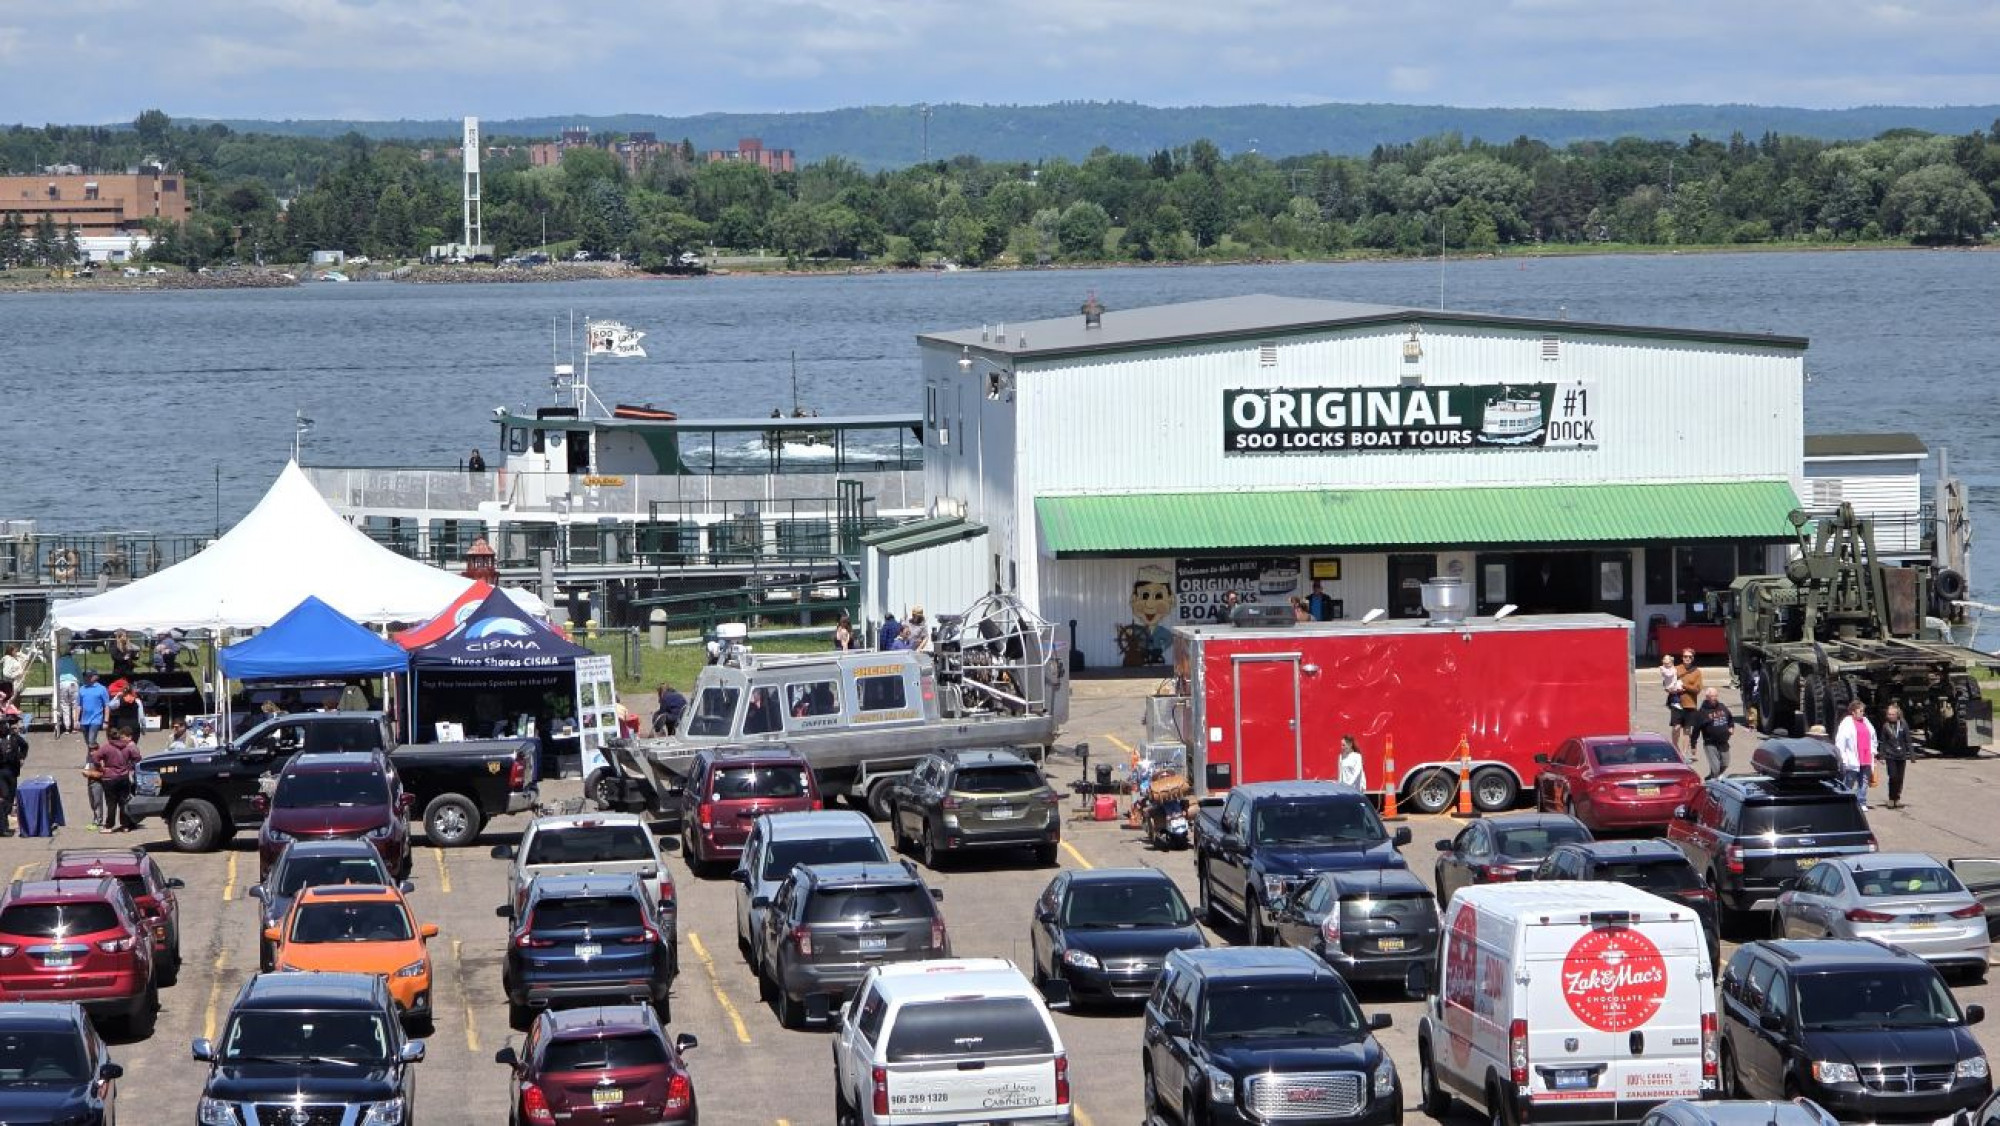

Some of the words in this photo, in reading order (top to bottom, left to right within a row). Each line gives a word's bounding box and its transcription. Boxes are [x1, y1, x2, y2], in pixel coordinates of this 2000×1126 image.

[1232, 390, 1462, 429] ORIGINAL
[1563, 389, 1588, 417] #1
[1550, 421, 1595, 441] DOCK
[1236, 433, 1276, 449] SOO
[1283, 432, 1345, 448] LOCKS
[1352, 431, 1403, 446] BOAT
[1408, 430, 1472, 445] TOURS
[1180, 578, 1254, 592] ORIGINAL
[1180, 593, 1209, 604] SOO
[1214, 592, 1257, 604] LOKS
[1180, 605, 1218, 619] BOA
[466, 640, 541, 651] CISMA
[450, 657, 481, 666] Three
[484, 657, 521, 667] Shores
[524, 656, 558, 667] CISMA
[1587, 995, 1643, 1004] CHOCOLATE
[891, 1096, 907, 1105] 906
